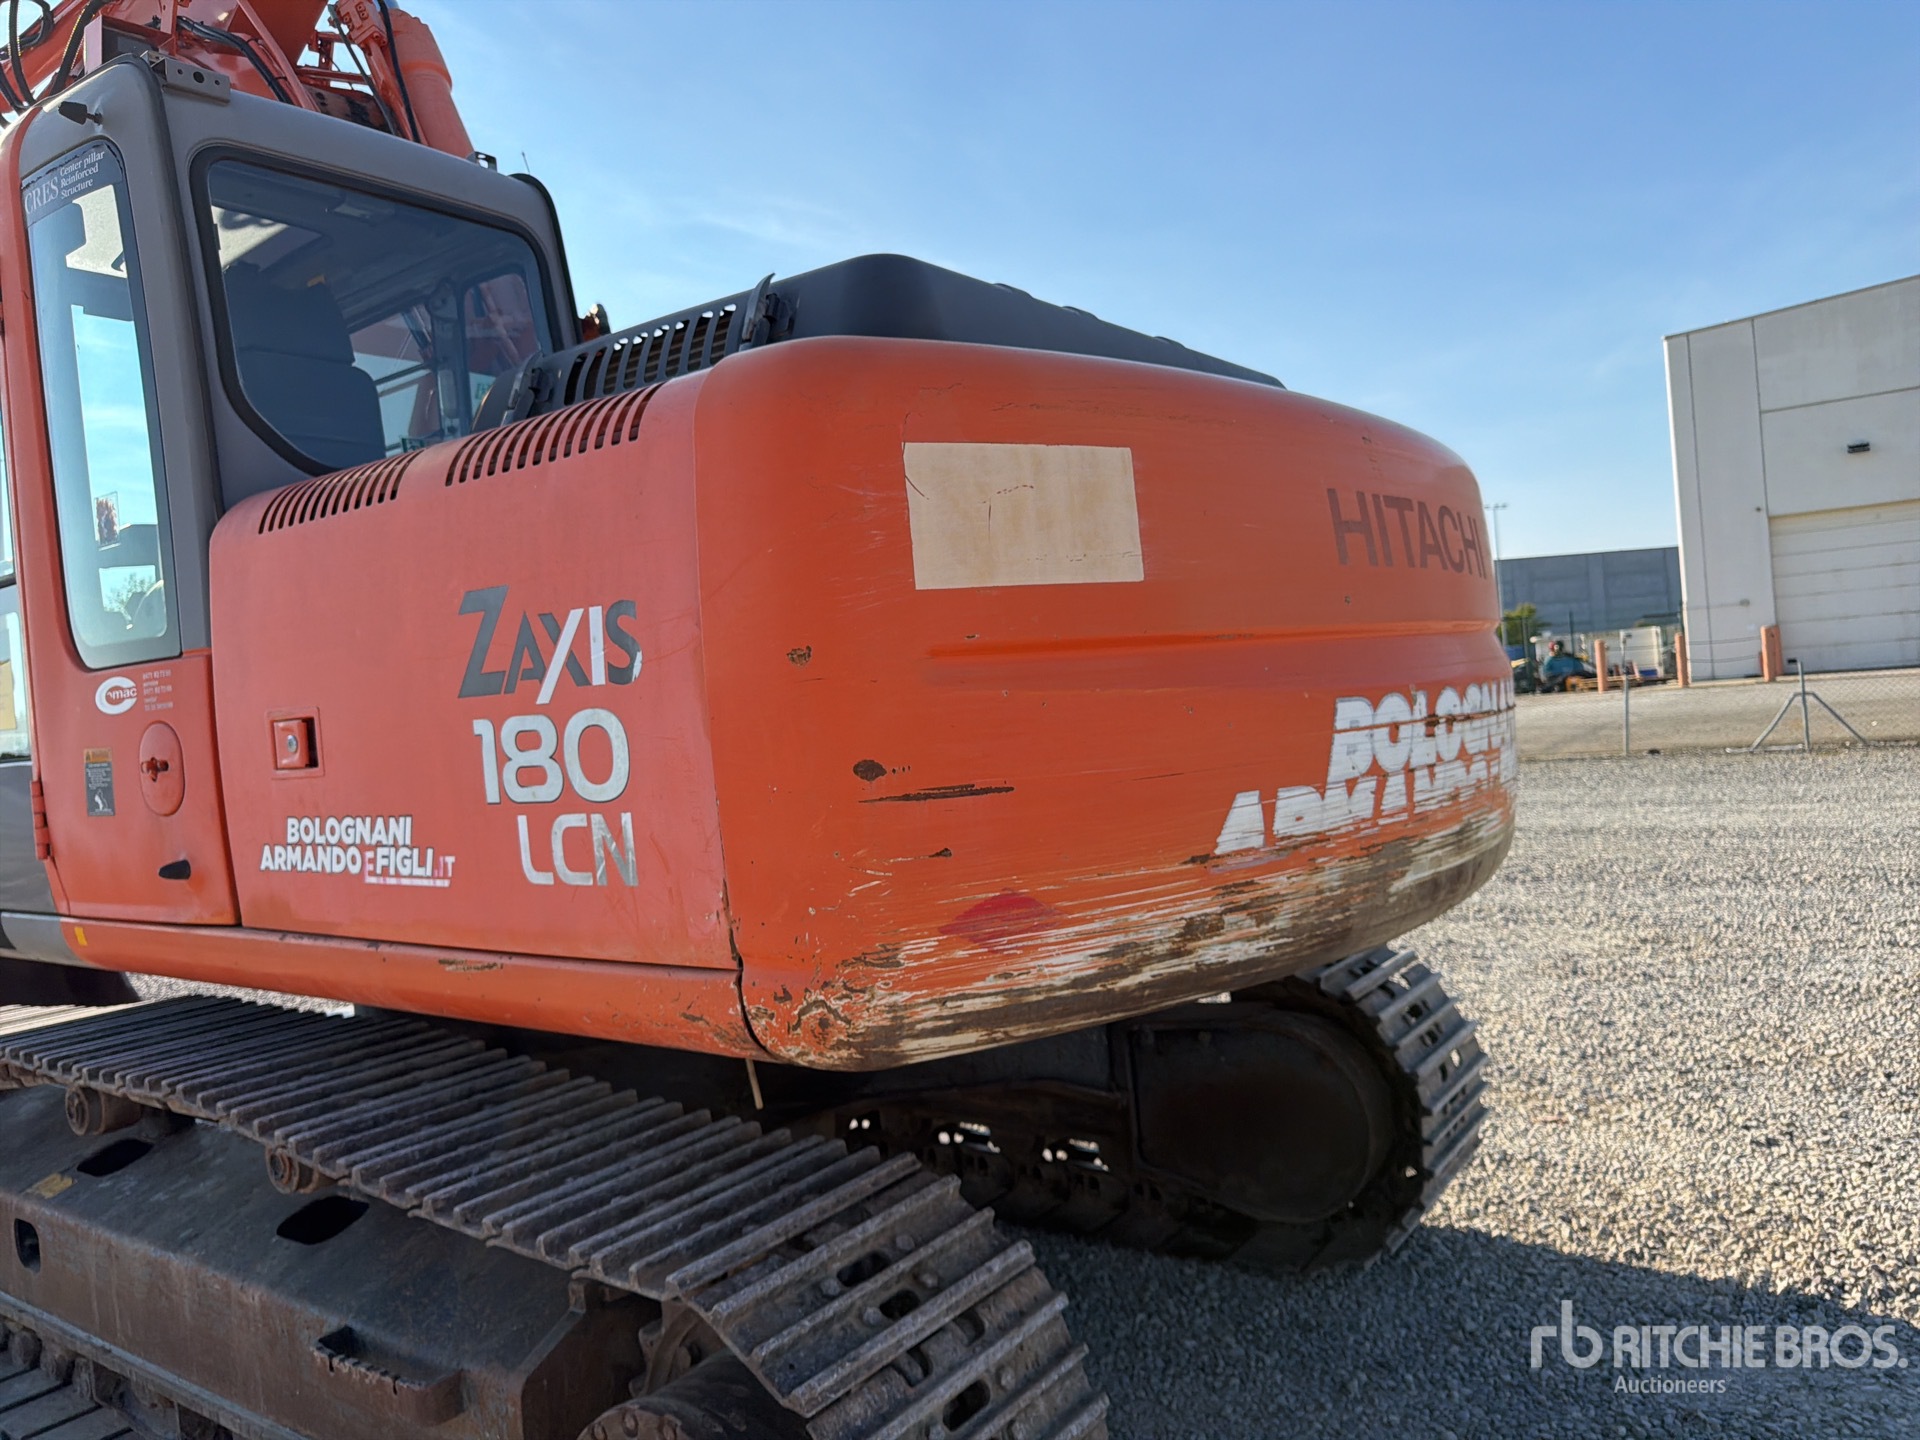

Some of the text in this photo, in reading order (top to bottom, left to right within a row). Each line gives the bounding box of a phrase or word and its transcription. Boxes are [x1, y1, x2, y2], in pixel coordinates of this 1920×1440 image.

[60, 151, 105, 177] Center pillar
[60, 162, 99, 188] Reinforced
[24, 176, 59, 215] CRES
[61, 178, 94, 200] Structure
[1327, 487, 1487, 579] HITACHI
[458, 585, 643, 705] ZAXIS
[473, 708, 630, 804] 180
[286, 815, 412, 846] BOLOGNANI
[260, 844, 363, 875] ARMANDO
[517, 812, 639, 887] LCN
